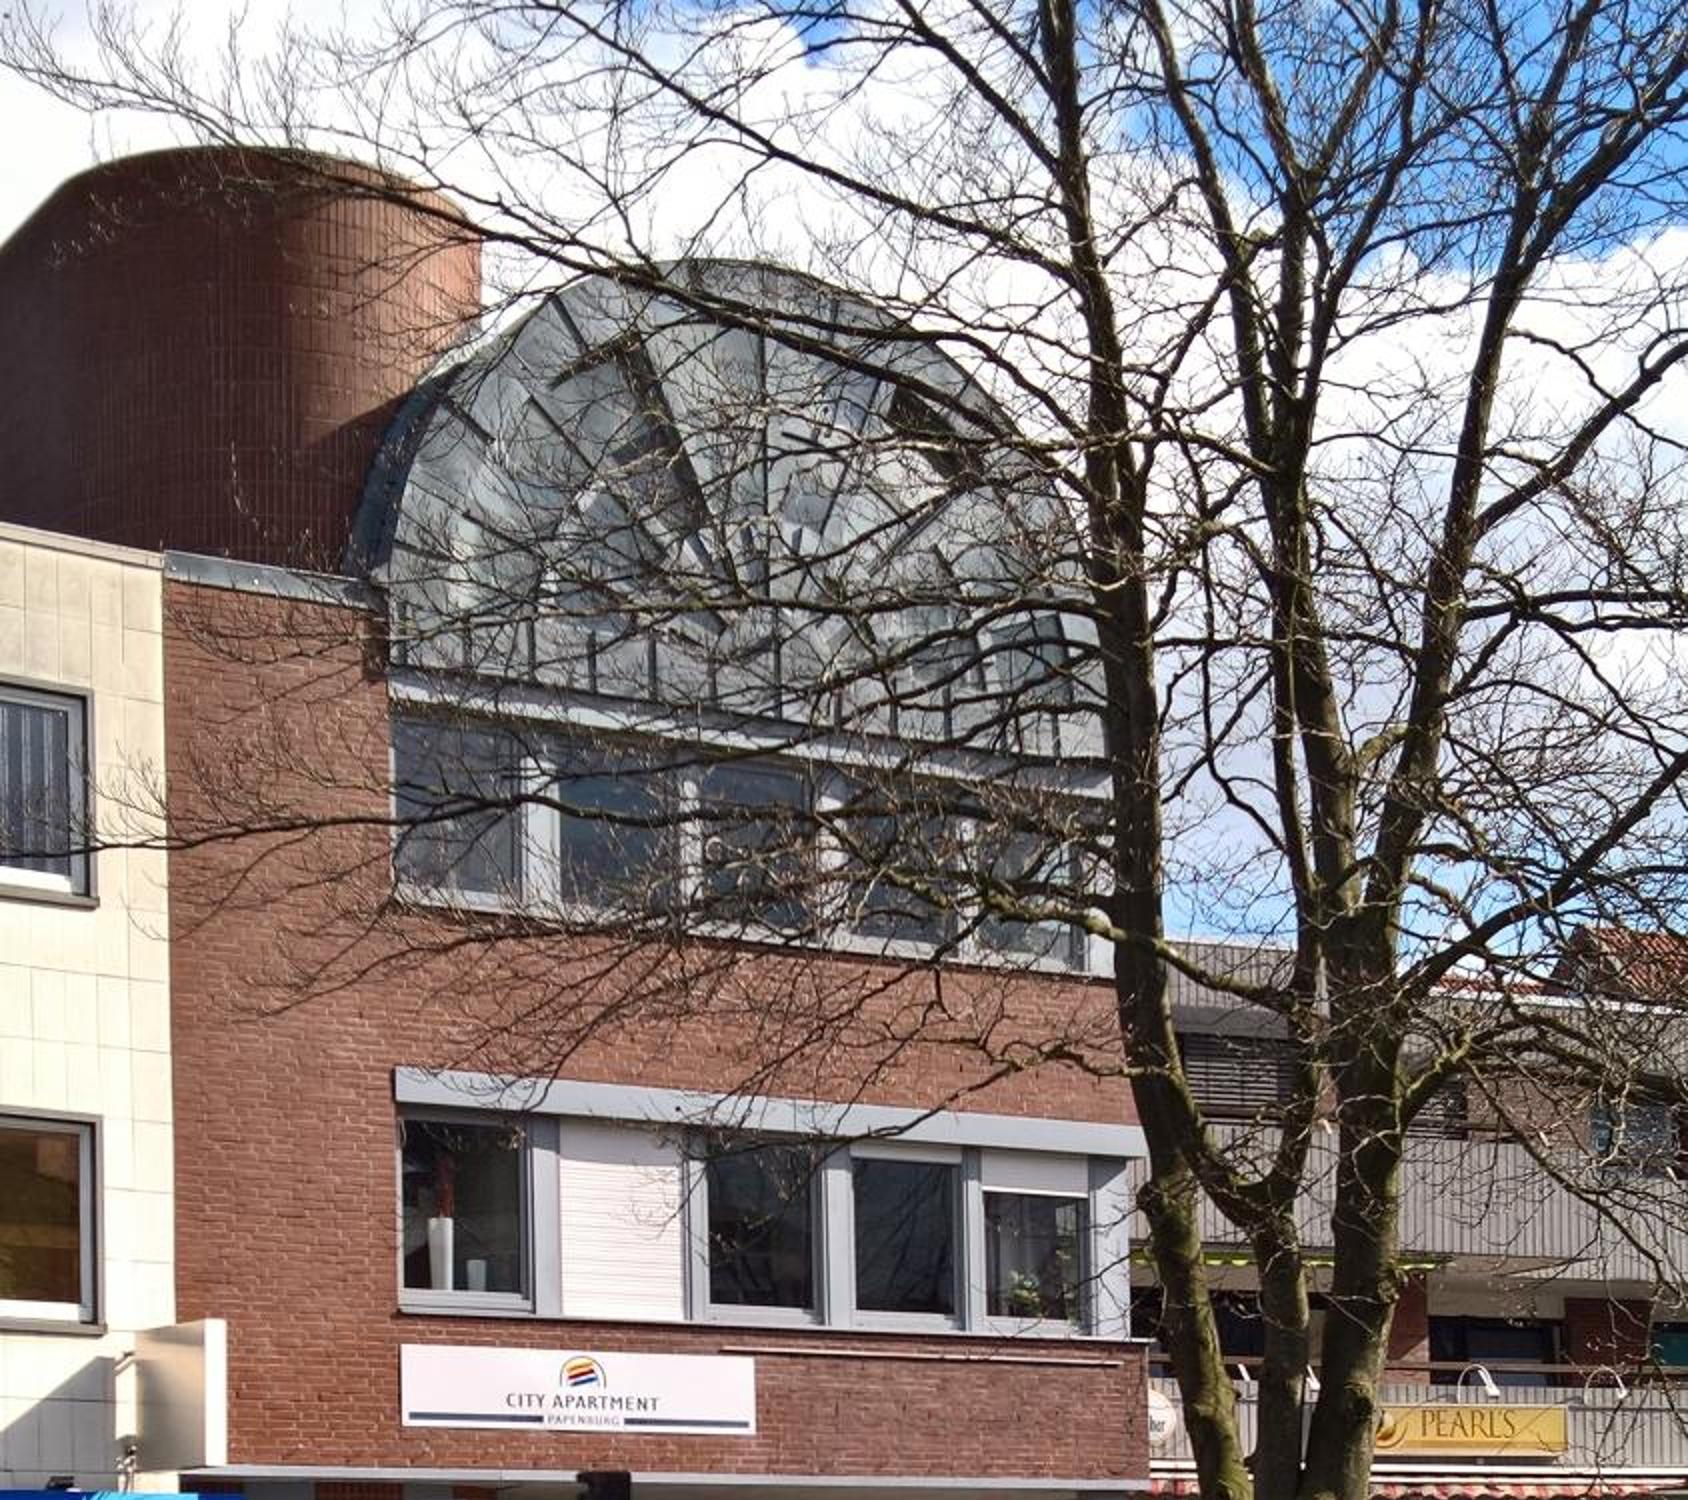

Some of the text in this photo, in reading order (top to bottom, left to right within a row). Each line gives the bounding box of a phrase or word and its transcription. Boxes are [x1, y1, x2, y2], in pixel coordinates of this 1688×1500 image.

[506, 1393, 659, 1411] CITY APARTMENT
[547, 1414, 620, 1426] PAPENBURG
